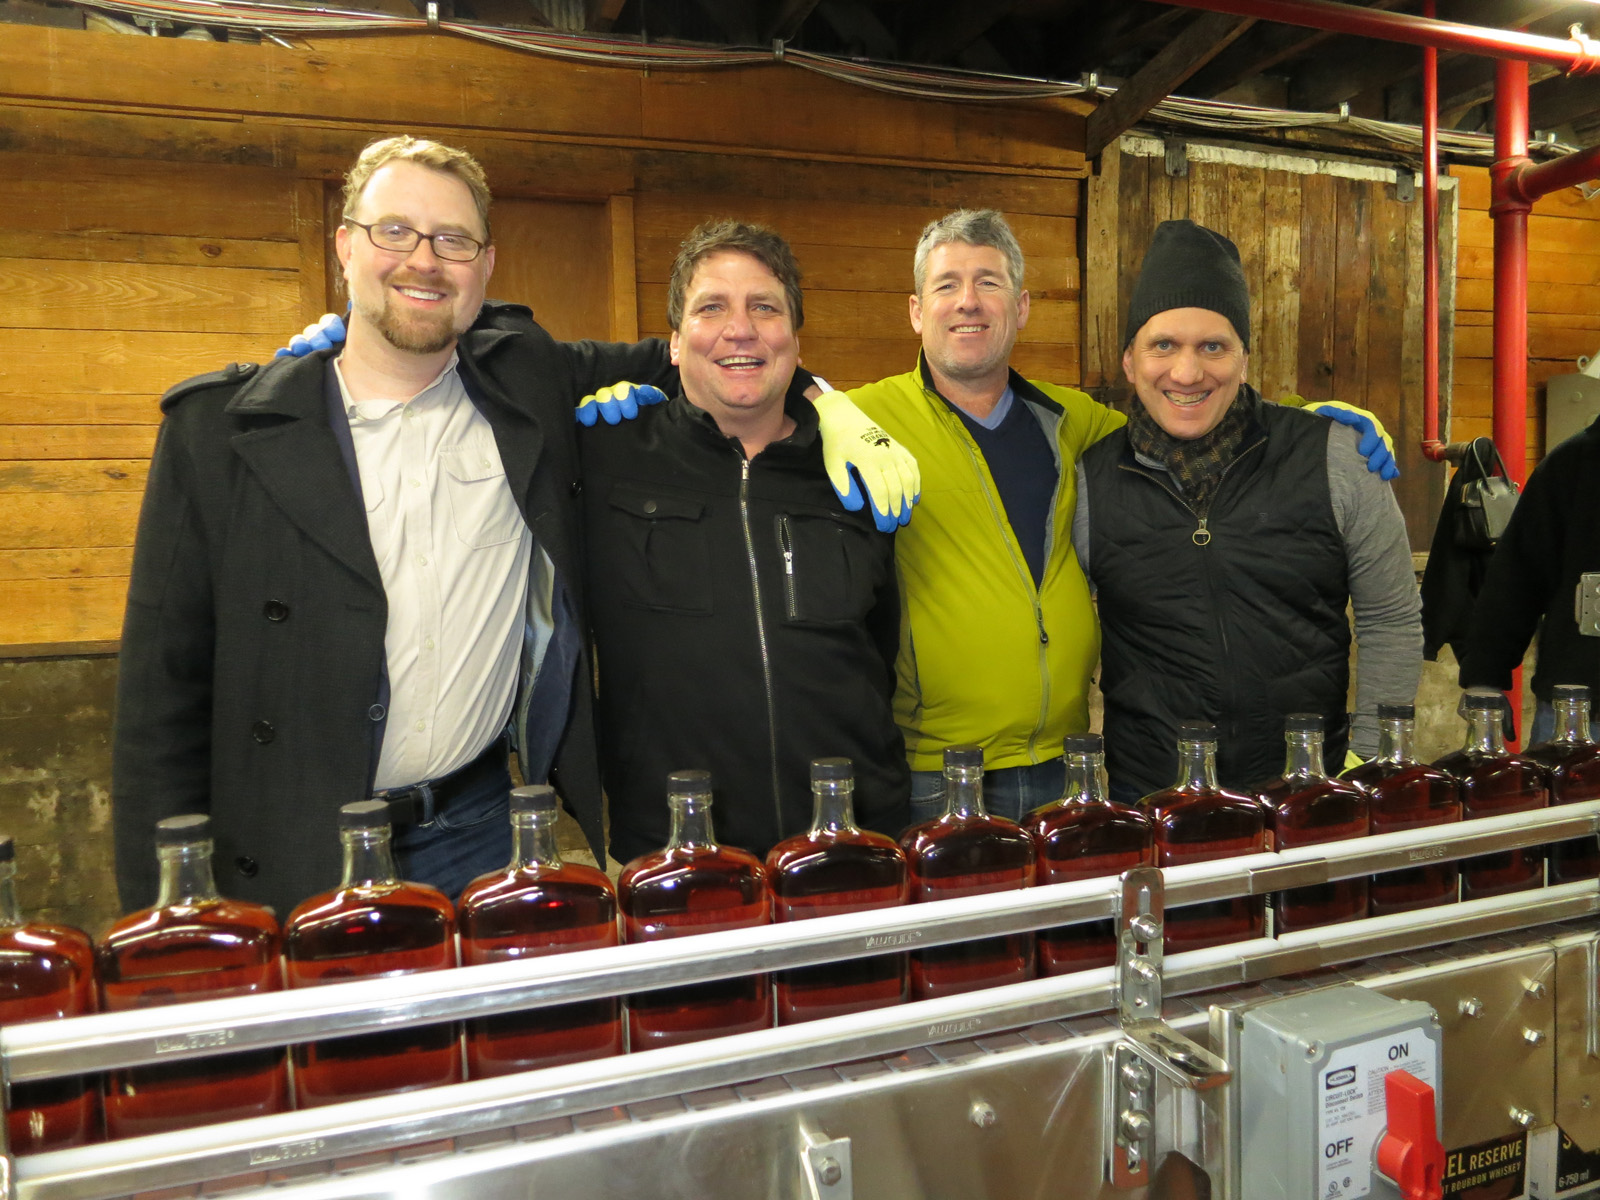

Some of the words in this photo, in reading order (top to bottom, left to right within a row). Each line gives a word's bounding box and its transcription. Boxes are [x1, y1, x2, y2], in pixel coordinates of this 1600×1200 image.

[1388, 1042, 1408, 1061] ON
[1325, 1136, 1354, 1158] OFF
[1442, 1152, 1466, 1179] EL
[1469, 1139, 1523, 1171] RESERVE
[1451, 1173, 1487, 1192] BOURBON
[1489, 1162, 1521, 1180] WHISKEY
[1558, 1172, 1579, 1188] 6-750
[1580, 1169, 1589, 1181] ml
